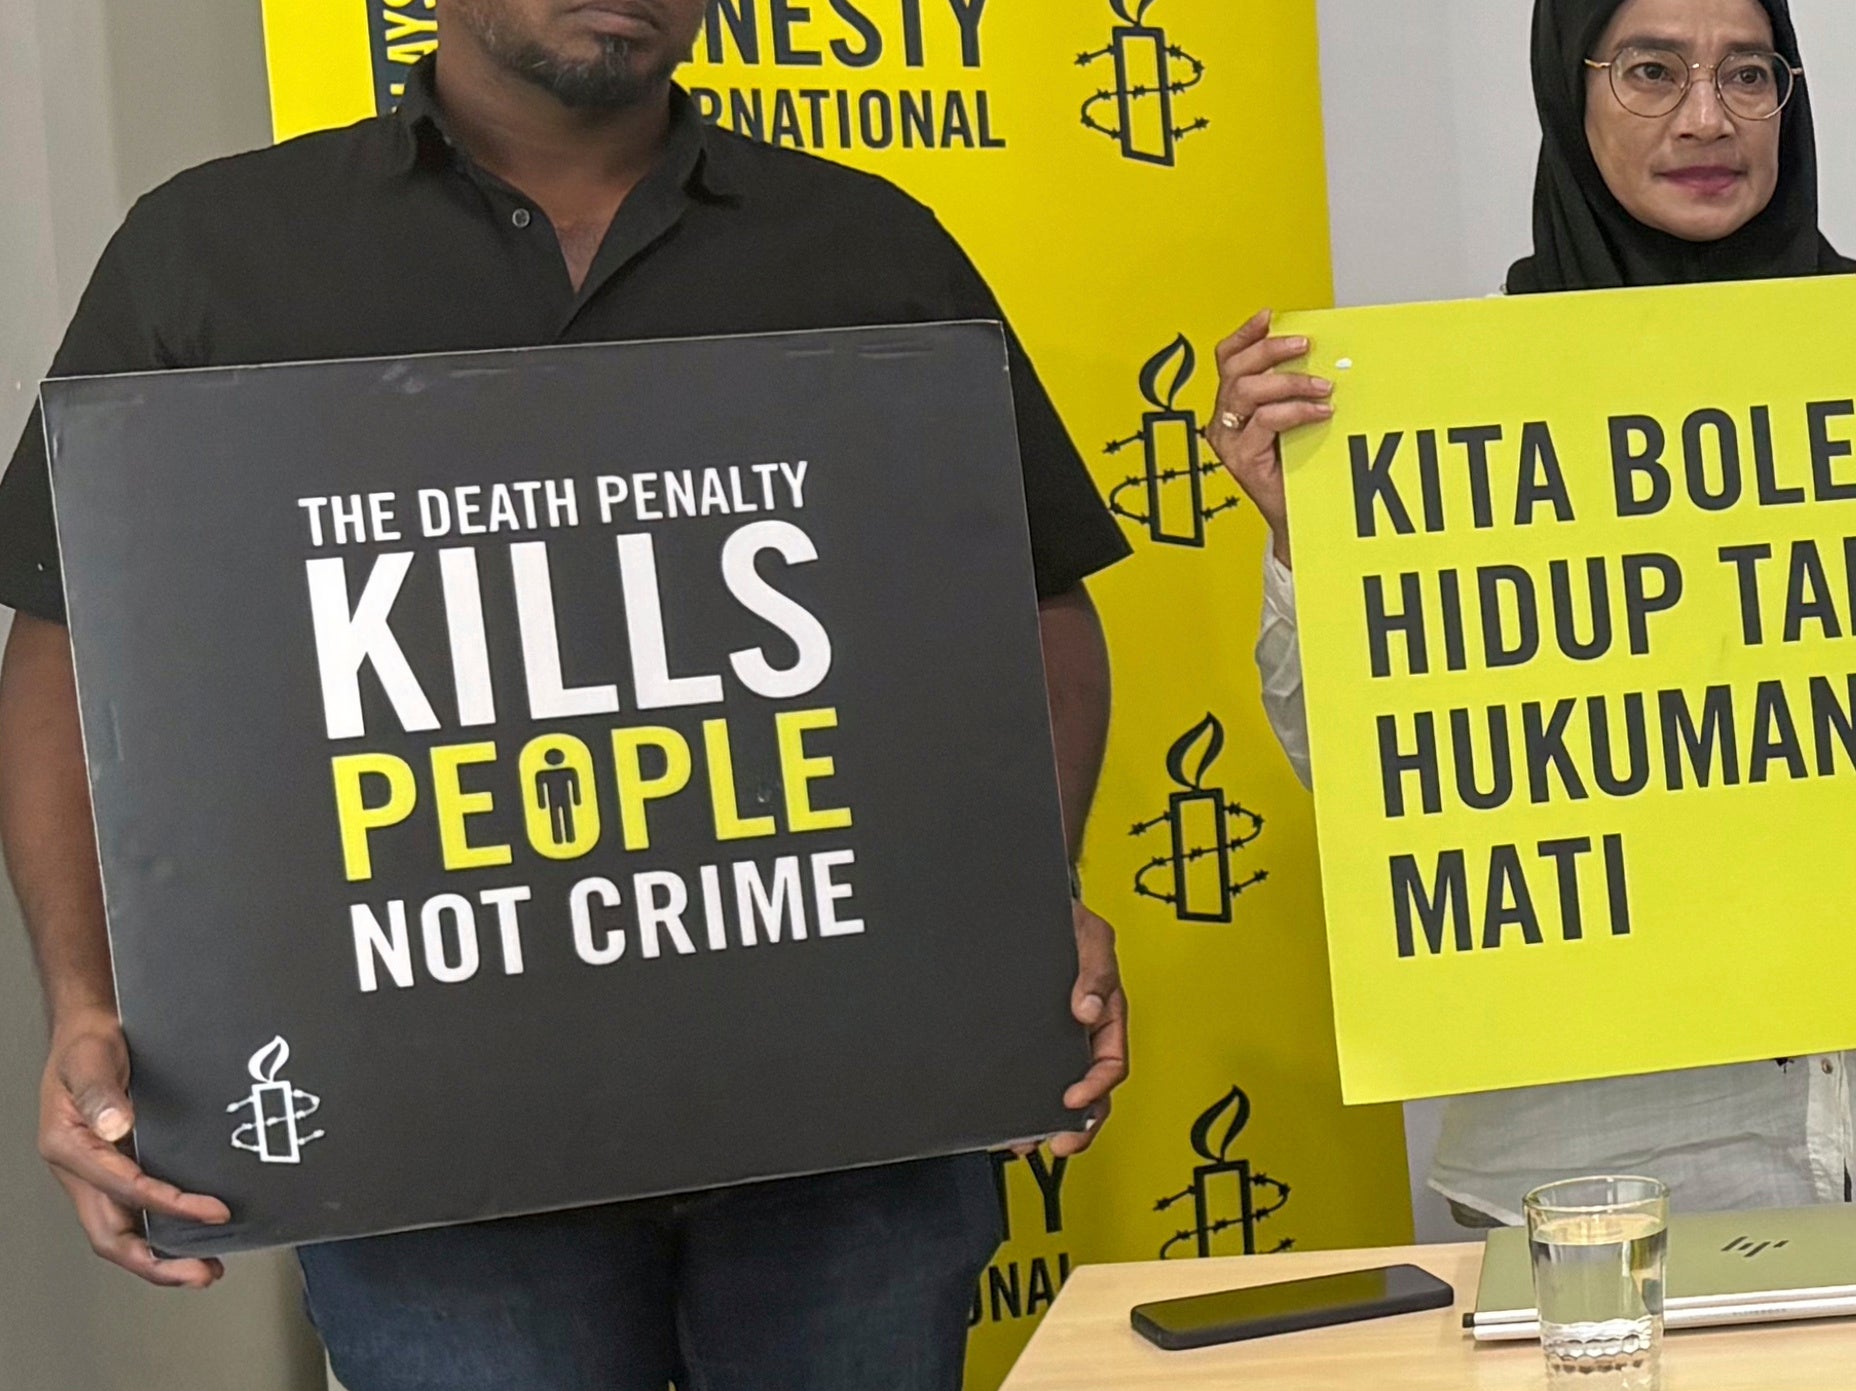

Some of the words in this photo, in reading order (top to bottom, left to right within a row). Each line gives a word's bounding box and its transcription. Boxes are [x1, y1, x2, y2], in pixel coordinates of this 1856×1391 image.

[690, 87, 1007, 149] RNATIONAL
[299, 490, 402, 549] THE
[418, 478, 580, 538] DEATH
[599, 461, 808, 524] PENALTY
[1348, 420, 1575, 538] KITA
[305, 519, 833, 740] KILLS
[1362, 551, 1684, 679] HIDUP
[331, 706, 853, 880] PEOPLE
[349, 885, 532, 993] NOT
[568, 849, 866, 965] CRIME
[1389, 832, 1632, 959] MATI
[1721, 1236, 1789, 1257] hp
